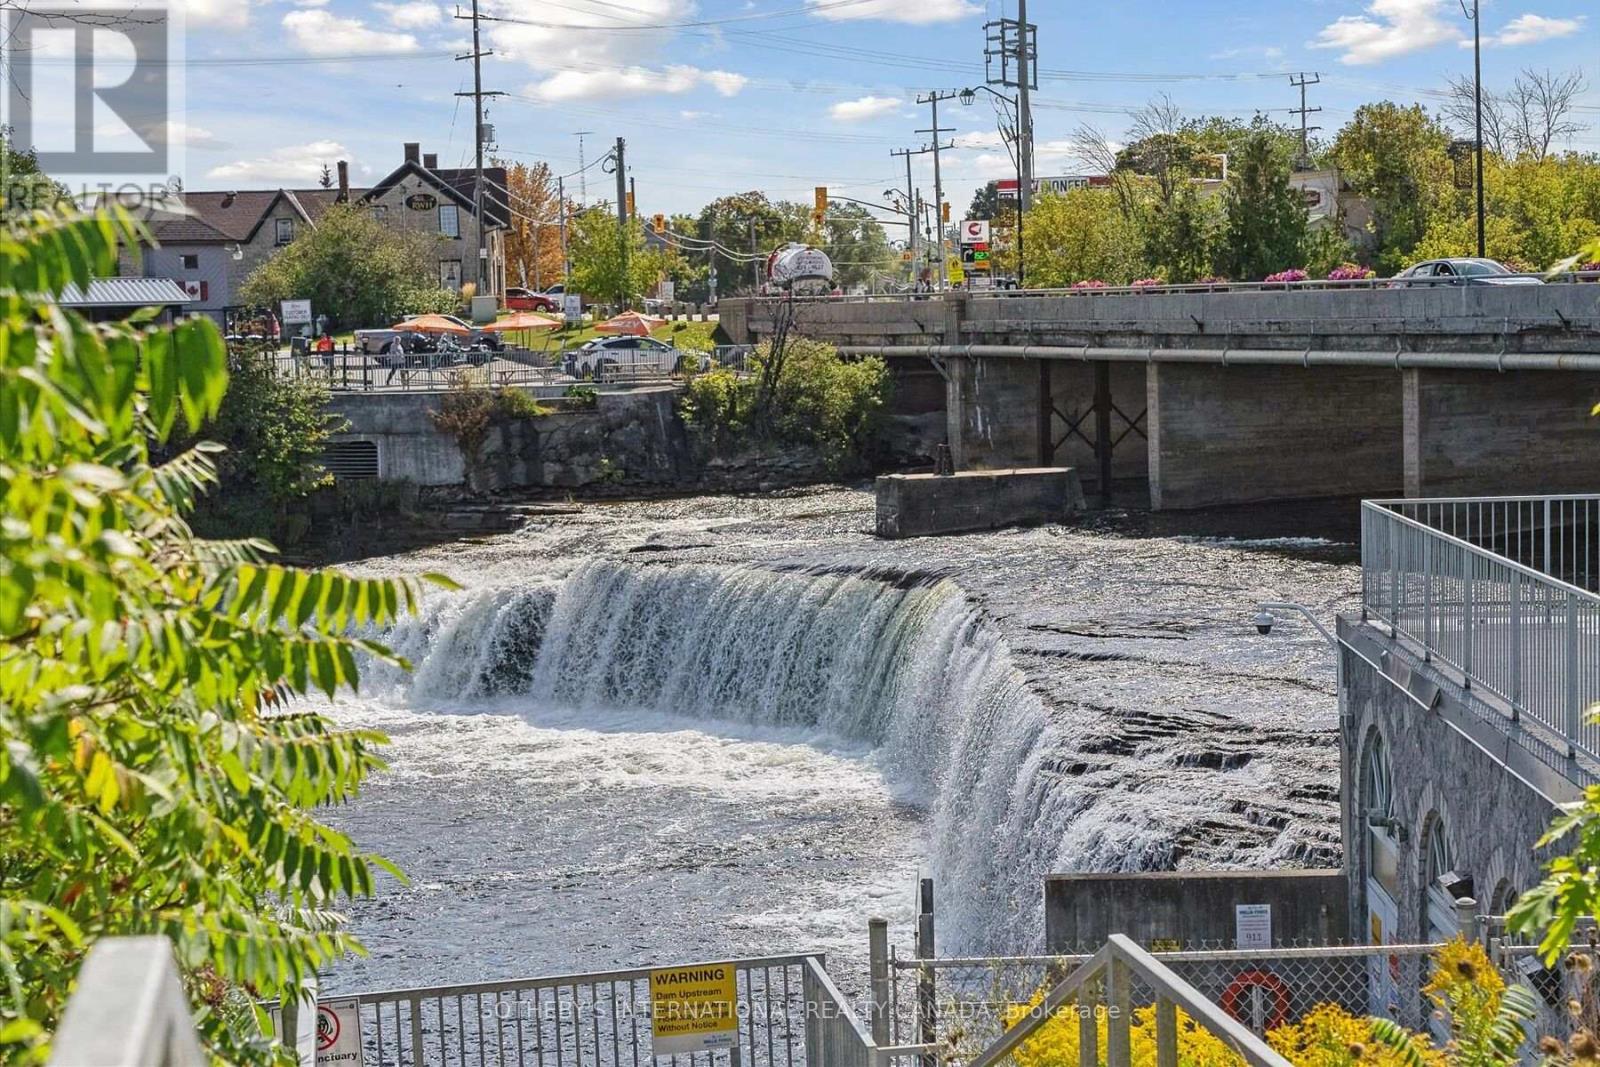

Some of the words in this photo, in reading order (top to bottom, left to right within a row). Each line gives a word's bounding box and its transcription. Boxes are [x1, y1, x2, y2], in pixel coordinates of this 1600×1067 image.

[656, 969, 725, 985] WARNING
[656, 992, 677, 1000] Dam
[679, 988, 722, 999] Upstream
[658, 1023, 690, 1032] Without
[692, 1020, 718, 1030] Notice
[318, 1051, 358, 1063] nctuary
